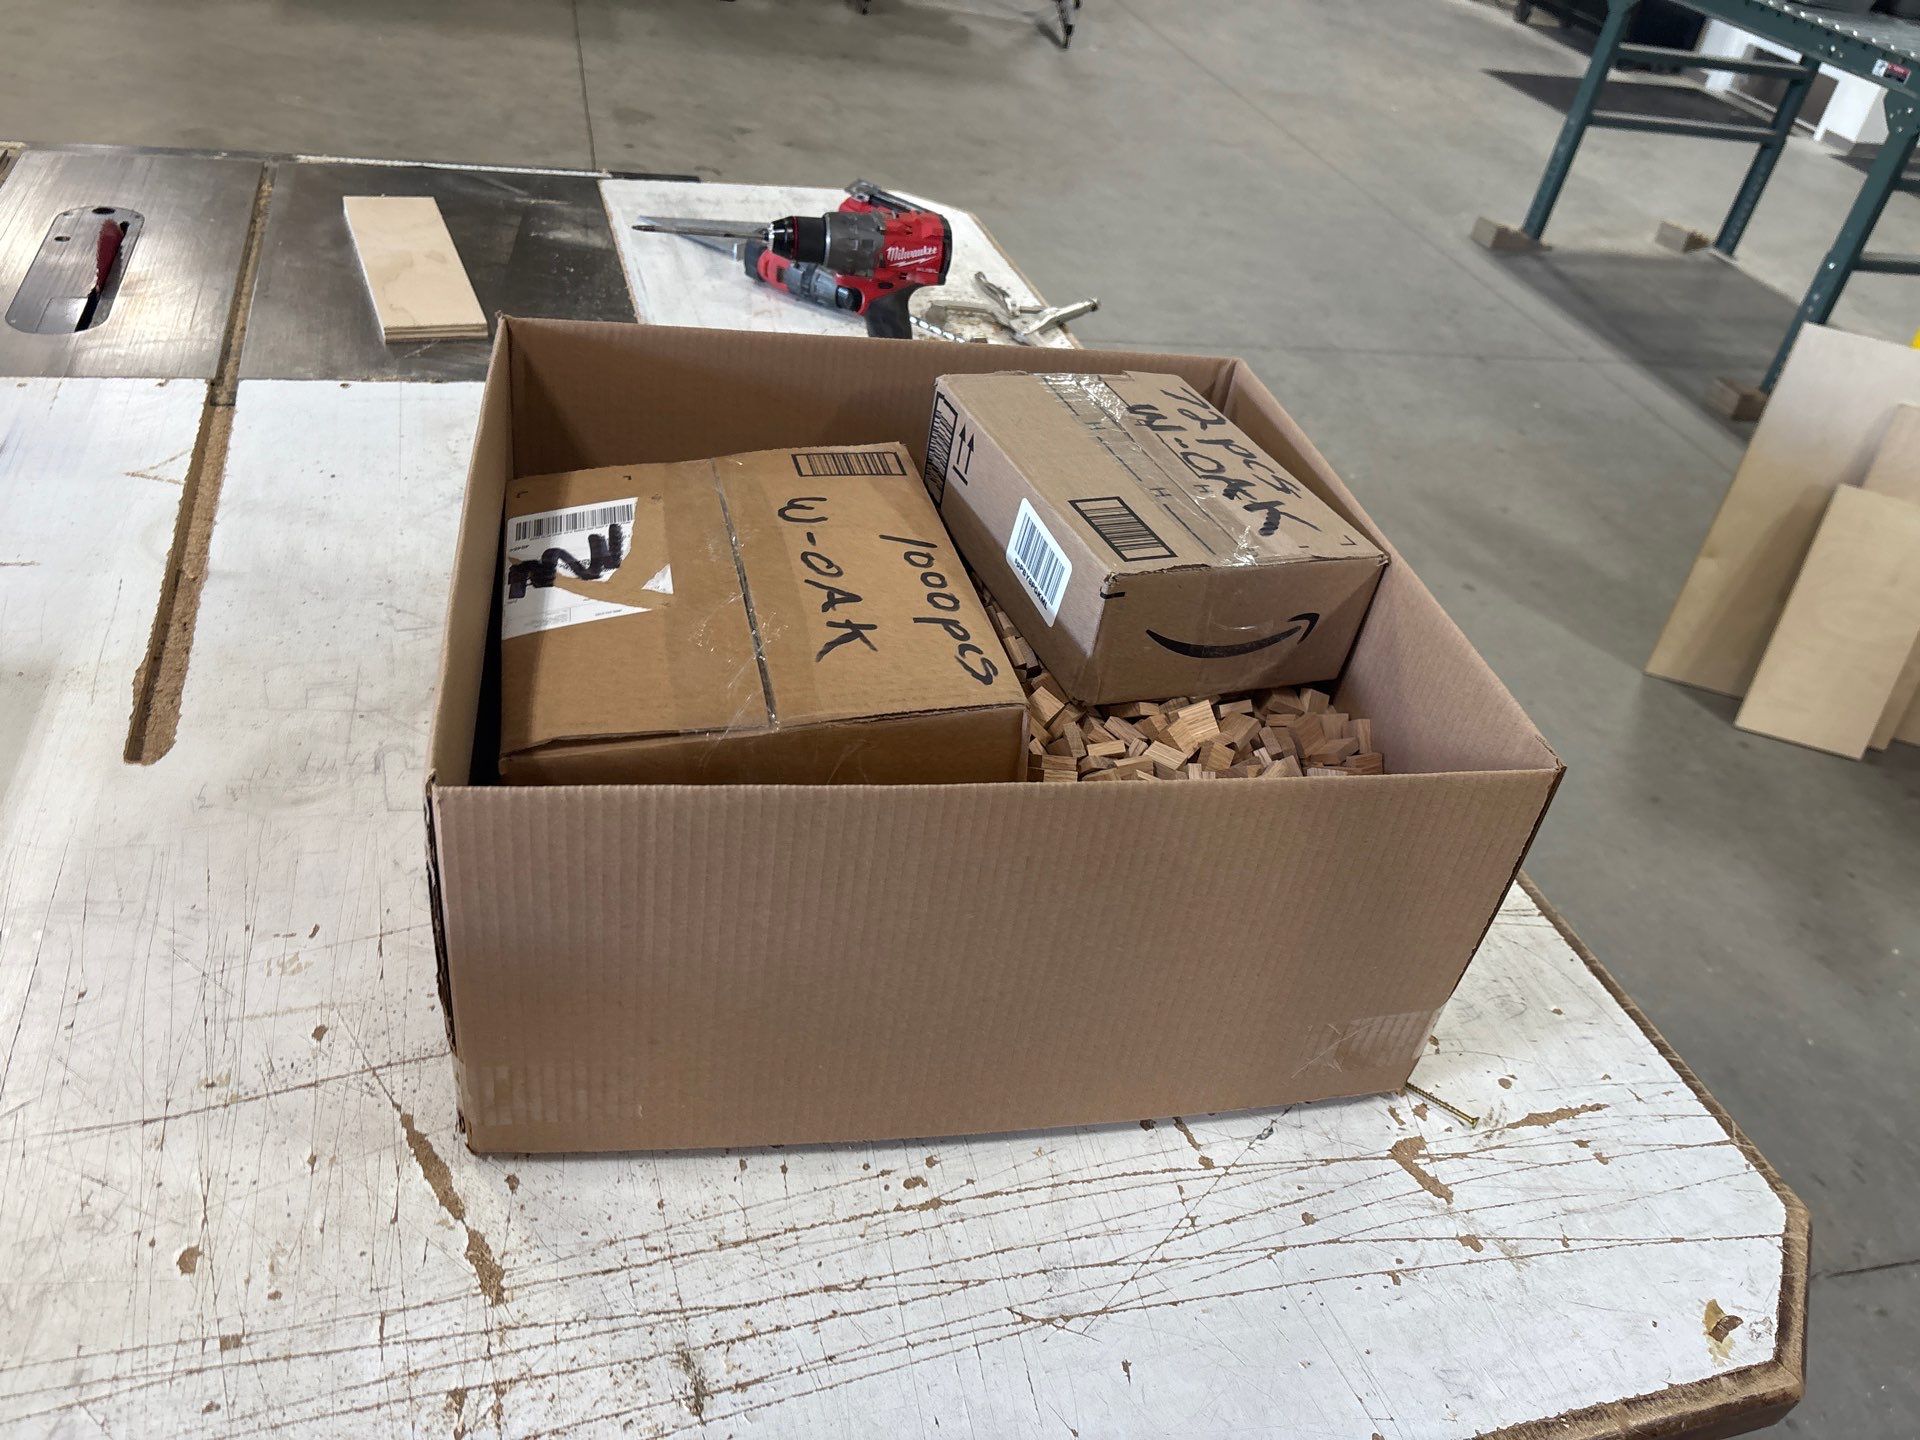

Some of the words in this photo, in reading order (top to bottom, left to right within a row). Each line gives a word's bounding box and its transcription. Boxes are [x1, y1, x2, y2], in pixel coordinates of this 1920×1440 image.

[886, 245, 938, 261] Milwaukee
[1126, 404, 1322, 536] W-OAK
[777, 496, 878, 663] W-OAK
